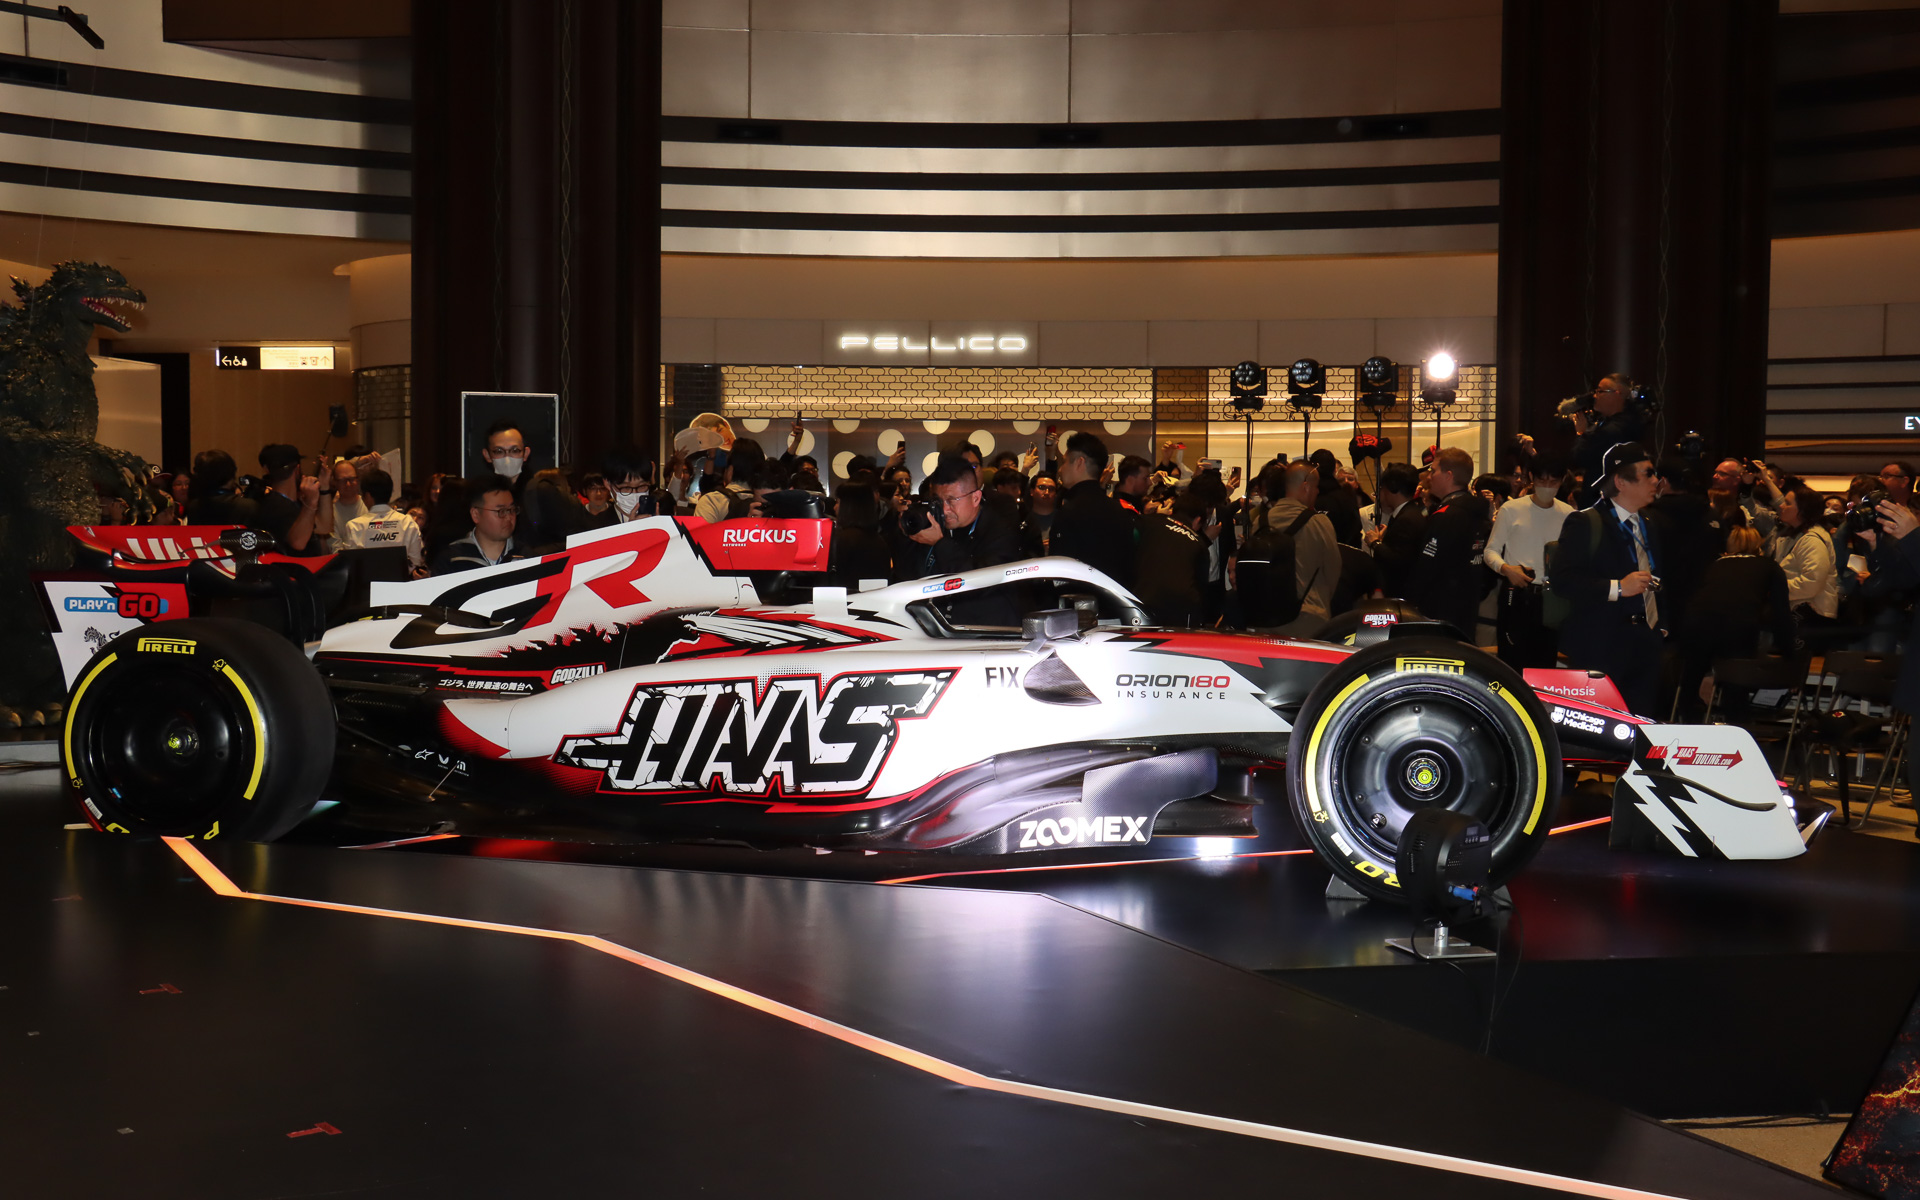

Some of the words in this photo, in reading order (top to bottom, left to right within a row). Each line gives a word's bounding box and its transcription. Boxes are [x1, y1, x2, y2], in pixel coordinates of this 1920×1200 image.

[841, 336, 1026, 350] PELLICO
[370, 532, 399, 541] HAAS
[722, 529, 797, 543] RUCKUS
[118, 593, 160, 618] GO
[137, 637, 197, 655] PIRELLI
[551, 664, 605, 685] GODZILLA
[1395, 657, 1466, 675] PIRELLI
[984, 666, 1020, 688] FIX
[1115, 674, 1231, 688] ORION180
[1117, 690, 1226, 700] INSURANCE
[1563, 718, 1603, 734] Medicine
[1566, 709, 1605, 726] UChicago
[560, 672, 956, 793] HAAS
[1677, 747, 1696, 758] HAAS
[1019, 816, 1148, 848] ZOOMEX
